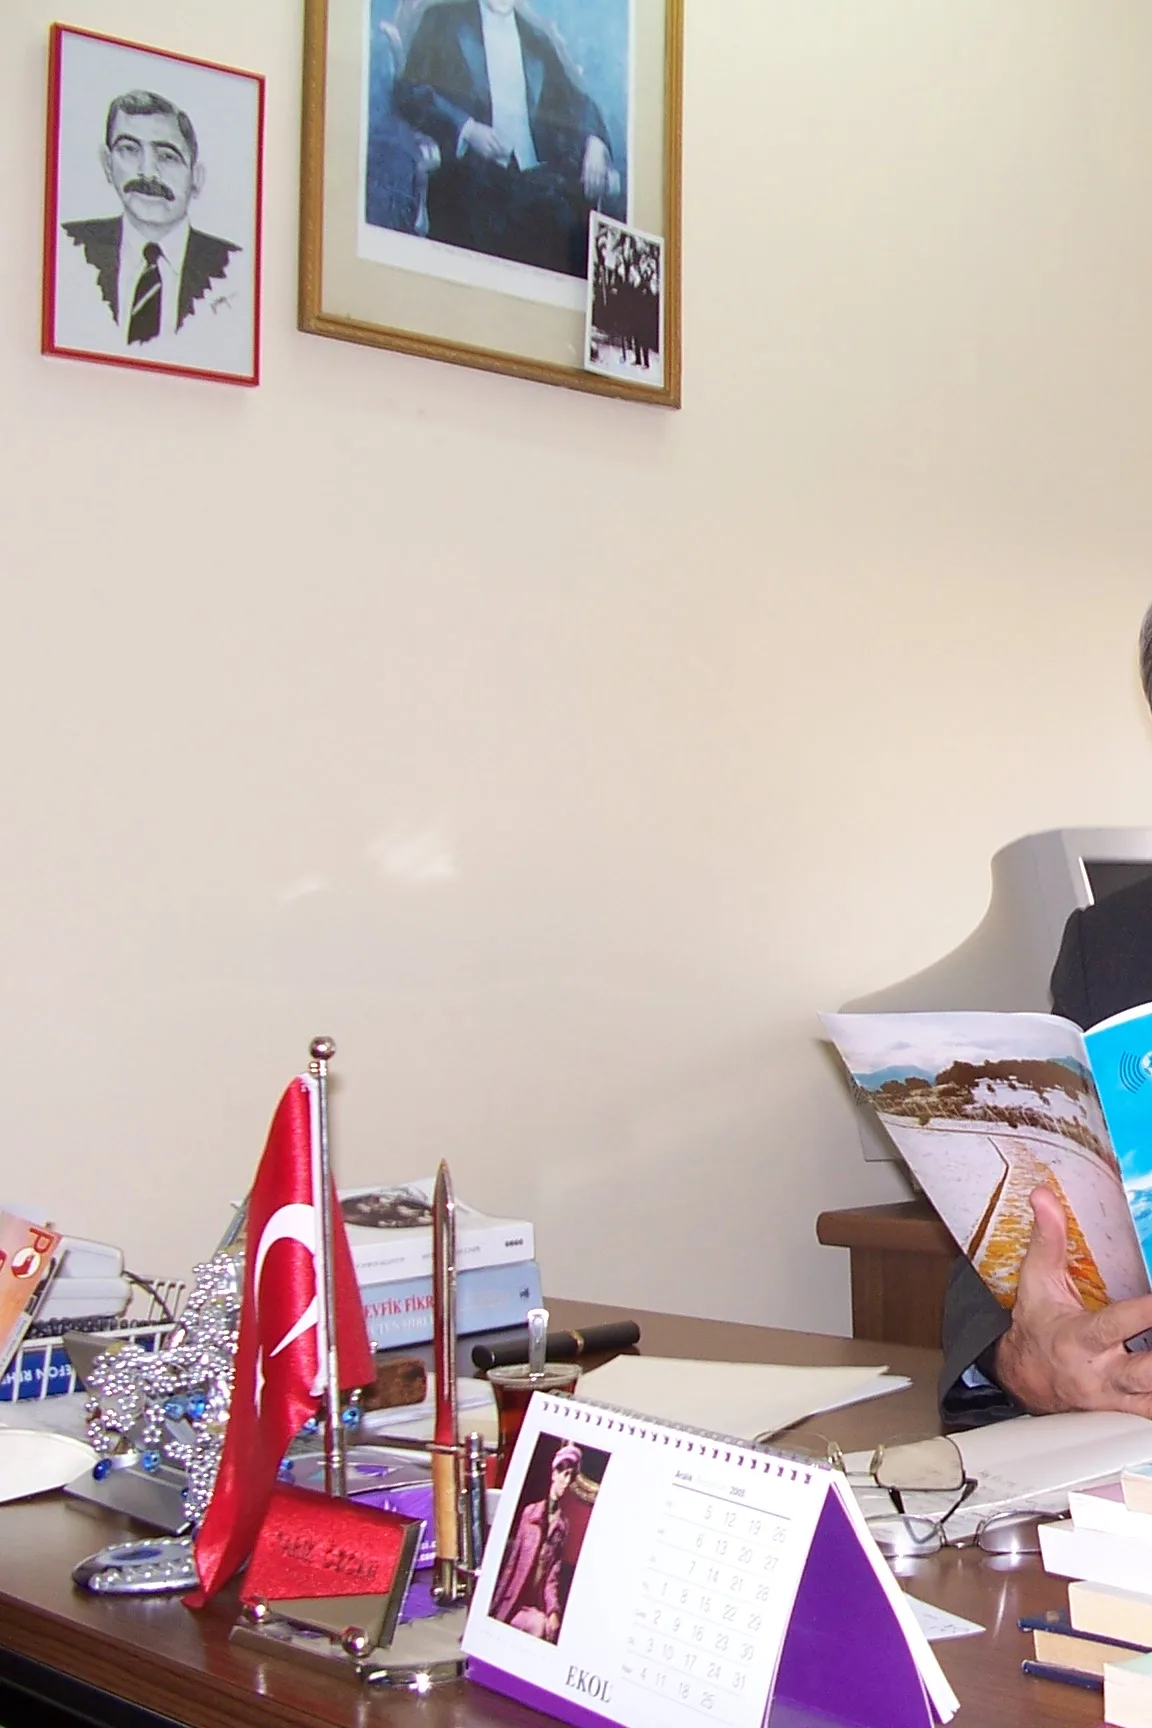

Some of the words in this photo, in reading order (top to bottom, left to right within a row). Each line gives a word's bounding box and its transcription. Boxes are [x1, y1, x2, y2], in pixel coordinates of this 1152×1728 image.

[365, 1297, 401, 1318] EVFİK
[704, 1505, 713, 1520] 5
[724, 1512, 736, 1527] 12
[749, 1520, 761, 1535] 19
[772, 1527, 787, 1543] 26
[696, 1532, 705, 1548] 6
[716, 1540, 728, 1555] 13
[738, 1546, 752, 1564] 20
[764, 1555, 779, 1573] 27
[688, 1561, 696, 1575] 7
[707, 1567, 719, 1583] 14
[730, 1576, 744, 1592] 21
[755, 1584, 769, 1601] 28
[661, 1582, 667, 1596] 1
[681, 1588, 688, 1604] 8
[700, 1596, 711, 1613] 15
[722, 1604, 738, 1621] 22
[747, 1613, 761, 1631] 29
[654, 1610, 661, 1625] 2
[673, 1617, 680, 1632] 9
[692, 1625, 704, 1641] 16
[715, 1633, 729, 1651] 23
[740, 1643, 754, 1660] 30
[565, 1665, 612, 1703] EKOL
[647, 1638, 653, 1653] 3
[663, 1644, 674, 1660] 10
[685, 1653, 697, 1670] 17
[707, 1662, 721, 1679] 24
[733, 1672, 746, 1690] 31
[640, 1667, 647, 1680] 4
[656, 1673, 666, 1688] 11
[679, 1682, 690, 1699] 18
[700, 1691, 715, 1709] 25
